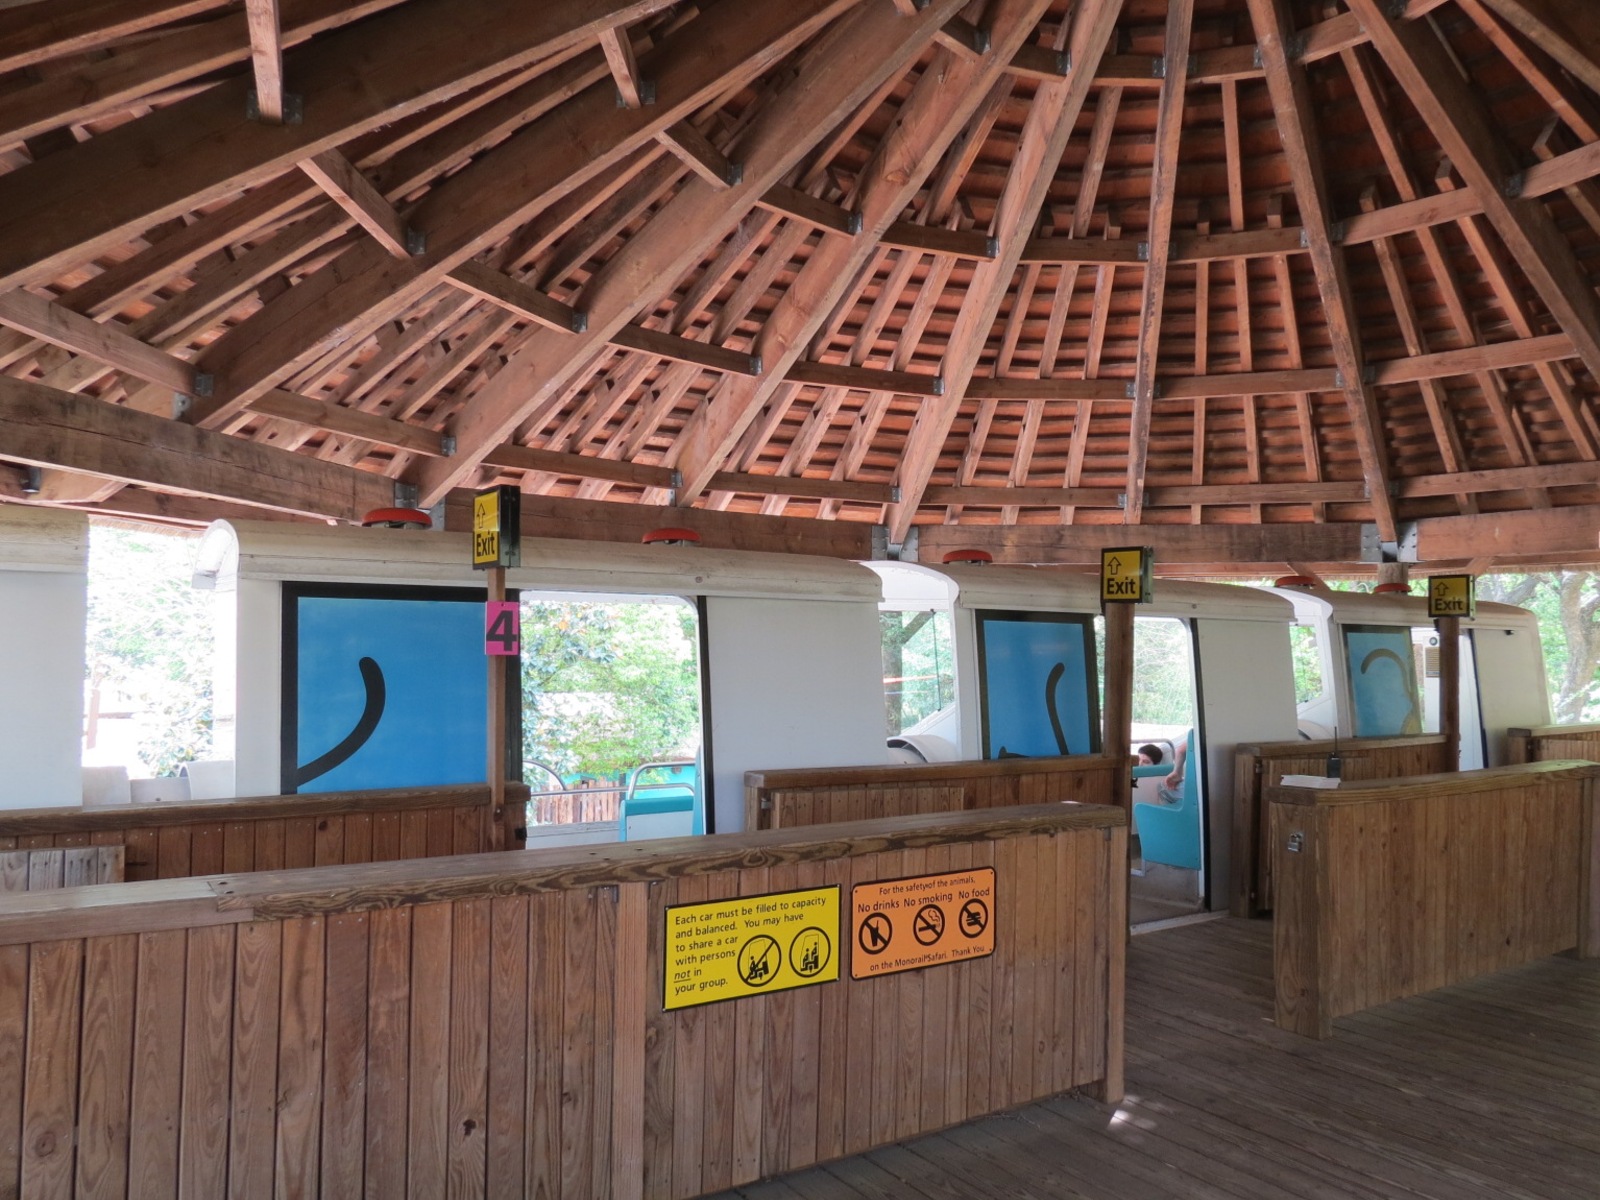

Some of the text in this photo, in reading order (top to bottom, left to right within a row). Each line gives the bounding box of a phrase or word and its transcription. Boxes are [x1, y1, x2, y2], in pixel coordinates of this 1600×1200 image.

[477, 530, 495, 557] Exit
[1107, 576, 1136, 595] Exit
[1435, 597, 1464, 611] Exit
[486, 610, 517, 652] 4
[879, 887, 890, 895] For
[892, 885, 904, 893] the
[906, 883, 926, 892] safety
[927, 880, 936, 889] of
[937, 880, 948, 888] the
[858, 887, 990, 913] No drinks No smoking No food
[675, 896, 826, 925] Each car must be filled to capacity
[675, 913, 804, 939] and balanced. You may have
[676, 944, 686, 953] to
[688, 940, 713, 951] share
[725, 936, 738, 944] car
[675, 949, 736, 966] with persons
[870, 963, 879, 971] on
[881, 961, 893, 969] the
[895, 954, 926, 967] Monorail
[952, 946, 971, 957] Thank
[973, 945, 985, 953] You
[674, 967, 702, 980] not in
[675, 978, 728, 995] your group.
